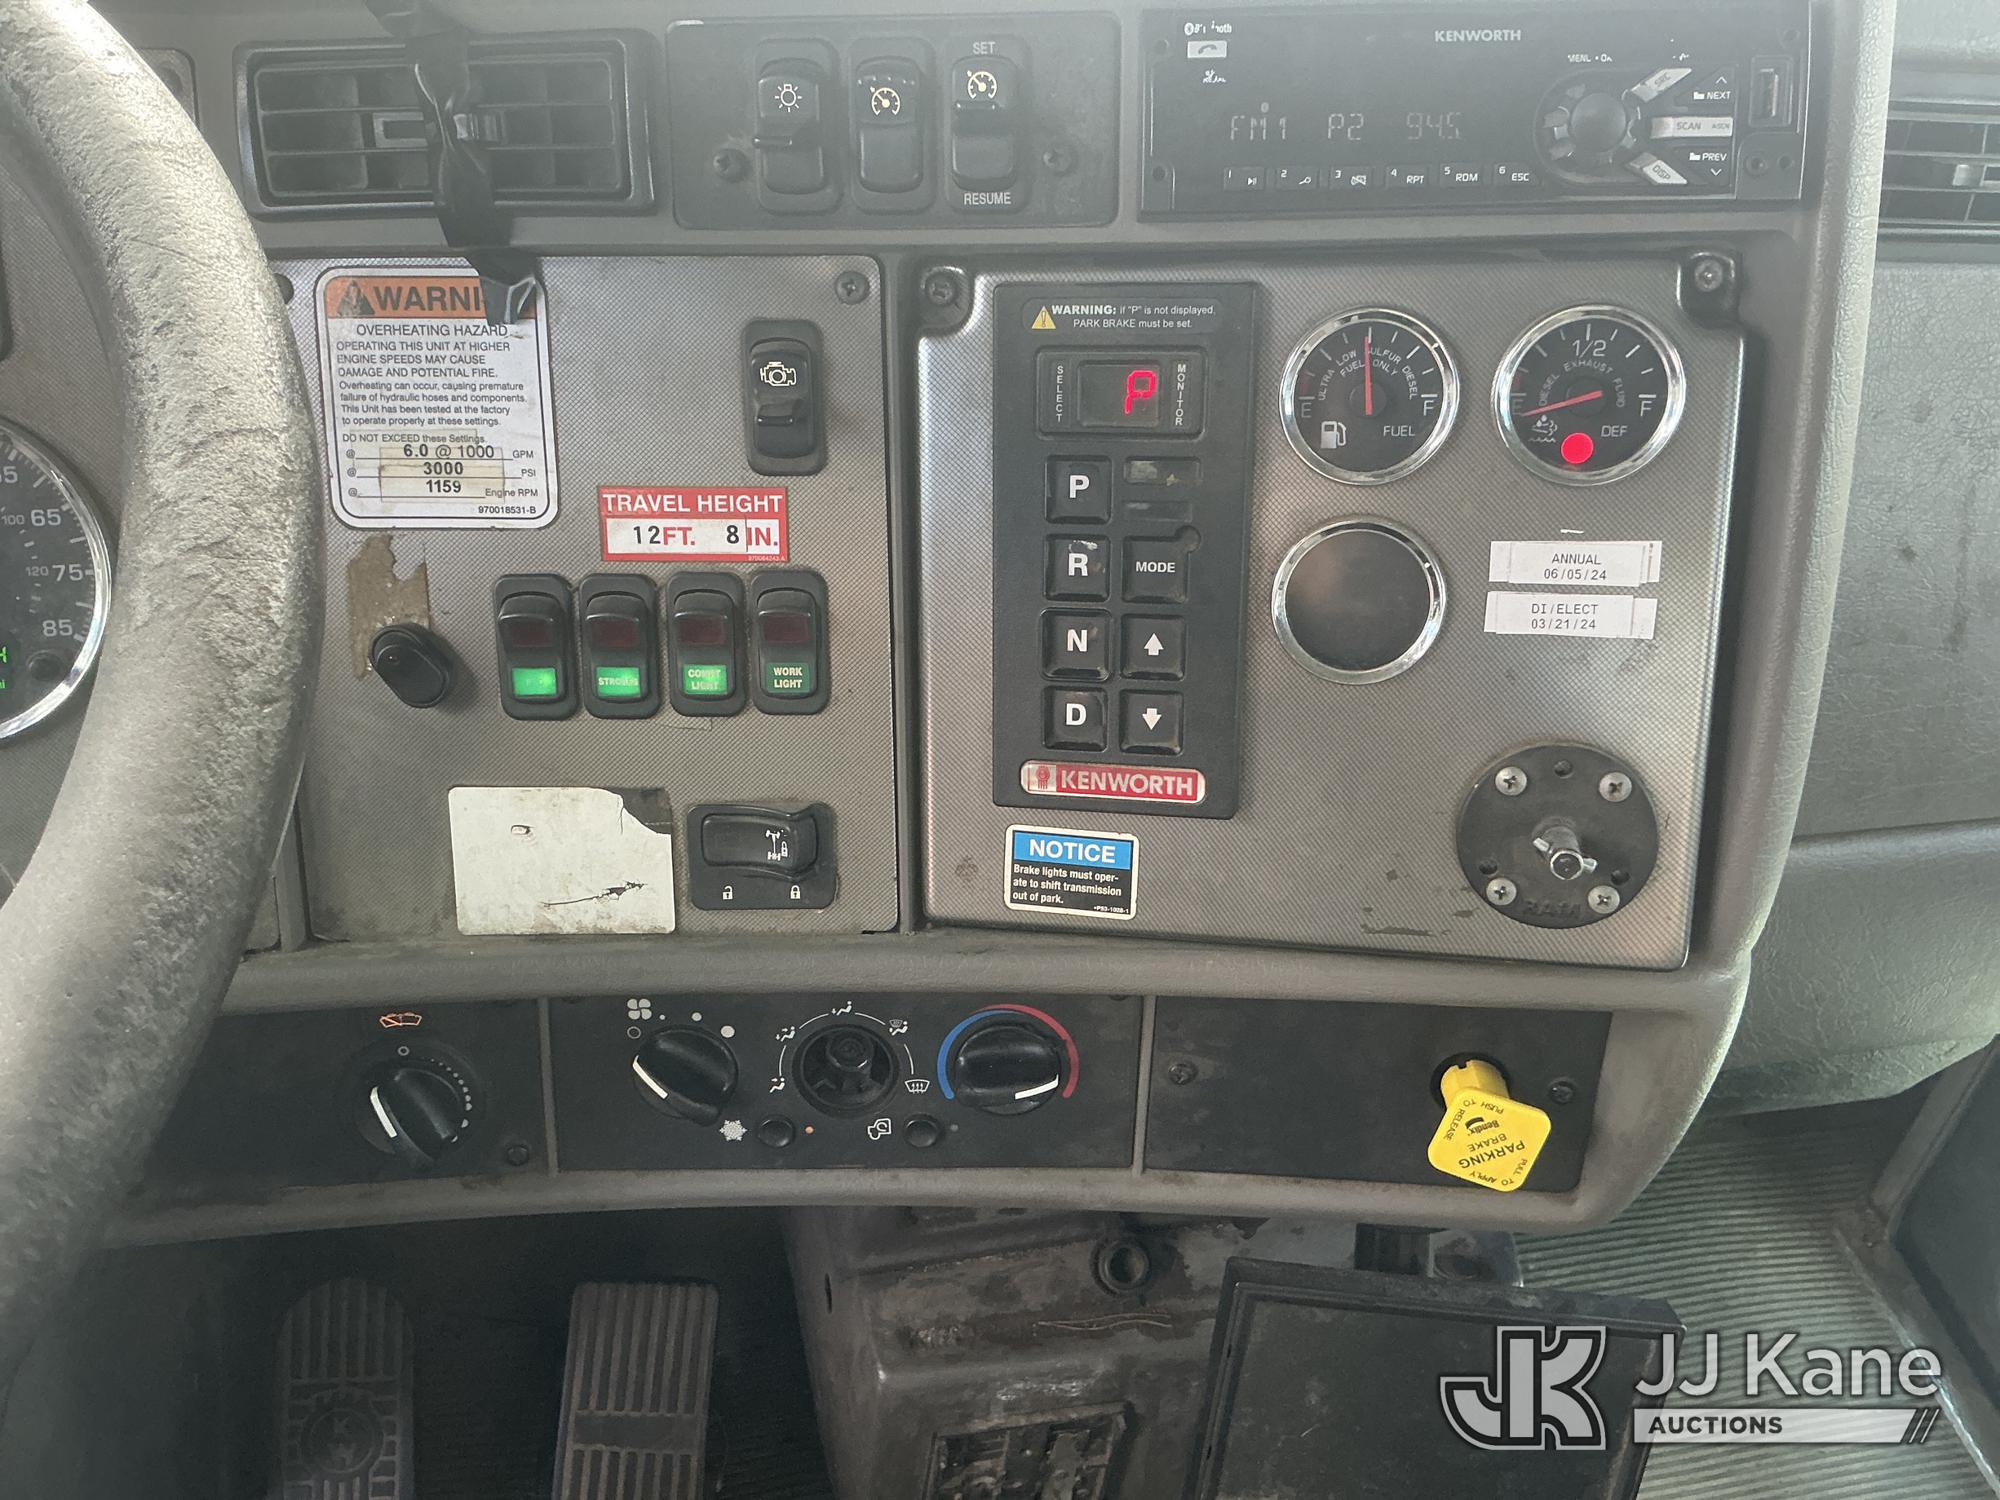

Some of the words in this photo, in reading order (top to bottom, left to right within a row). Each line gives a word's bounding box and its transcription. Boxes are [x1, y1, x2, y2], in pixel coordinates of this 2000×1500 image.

[1434, 29, 1521, 42] KENWORTH
[972, 42, 995, 54] SET
[1706, 92, 1731, 100] NEXT
[1328, 113, 1364, 140] P2
[1676, 122, 1702, 131] SCAN
[1702, 152, 1727, 161] PREV
[1280, 169, 1288, 178] 2
[1335, 169, 1342, 178] 3
[1390, 168, 1397, 177] 4
[1406, 174, 1425, 184] RPT
[1455, 172, 1479, 182] RDM
[1499, 165, 1506, 174] 6
[1511, 172, 1530, 182] ESC
[1652, 164, 1671, 181] DISP
[964, 192, 1011, 205] RESUME
[373, 286, 486, 311] WARNI
[1052, 305, 1116, 314] WARNING:
[1145, 306, 1151, 314] is
[1171, 306, 1215, 316] displayed.
[356, 324, 450, 336] OVERHEATING
[454, 325, 508, 336] HAZARD
[1074, 319, 1100, 327] PARK
[1103, 319, 1135, 328] BRAKE
[1139, 320, 1160, 328] must
[1163, 319, 1174, 328] be
[1177, 320, 1192, 328] set.
[336, 341, 396, 351] OPERATING
[400, 341, 423, 351] THIS
[426, 341, 450, 351] UNIT
[453, 342, 466, 351] AT
[469, 342, 510, 352] HIGHER
[1572, 340, 1607, 357] 1/2
[337, 354, 377, 364] ENGINE
[380, 354, 422, 364] SPEEDS
[425, 355, 447, 364] MAY
[450, 355, 486, 364] CAUSE
[338, 368, 383, 377] DAMAGE
[386, 368, 408, 377] AND
[411, 368, 469, 378] POTENTIAL
[472, 368, 498, 378] FIRE.
[1318, 369, 1335, 400] ULTRA
[1336, 350, 1357, 366] LOW
[1368, 348, 1402, 364] ULFUR
[1402, 365, 1418, 399] DIESEL
[1340, 360, 1365, 378] FUEL
[1372, 359, 1399, 376] ONLY
[339, 381, 392, 391] Overheating
[394, 382, 411, 390] can
[413, 382, 440, 391] occur,
[442, 382, 476, 392] causing
[480, 383, 524, 392] premature
[1539, 373, 1560, 406] DIESEL
[1563, 359, 1613, 374] EXHAUST
[1613, 378, 1625, 407] FLUID
[340, 393, 367, 401] failure
[380, 393, 420, 403] hydraulic
[422, 393, 449, 402] hoses
[452, 394, 468, 402] and
[470, 394, 527, 403] components.
[1056, 365, 1064, 422] SELECT
[1124, 370, 1158, 414] P
[1175, 364, 1186, 425] MONITOR
[341, 405, 360, 413] This
[362, 405, 380, 413] Unit
[382, 405, 398, 413] has
[400, 405, 422, 413] been
[424, 405, 451, 414] tested
[454, 406, 462, 414] at
[464, 406, 479, 414] the
[480, 406, 510, 416] factory
[1301, 402, 1312, 418] E
[1423, 400, 1433, 416] F
[1640, 401, 1652, 416] F
[353, 417, 386, 426] operate
[388, 417, 425, 426] properly
[464, 417, 501, 427] settings.
[1383, 426, 1415, 436] FUEL
[1601, 425, 1628, 437] DEF
[342, 434, 356, 442] DO
[360, 434, 378, 442] NOT
[382, 434, 420, 442] EXCEED
[422, 434, 446, 442] these
[449, 434, 486, 444] Settings.
[403, 444, 428, 457] 6.0
[436, 444, 452, 460] @
[458, 445, 494, 458] 1000
[512, 450, 534, 458] GPM
[423, 462, 464, 475] 3000
[521, 469, 536, 477] PSI
[425, 480, 462, 492] 1159
[485, 488, 516, 498] Engine
[1068, 474, 1090, 498] P
[478, 506, 536, 514] 970018531-B
[603, 494, 690, 512] TRAVEL
[697, 495, 783, 513] HEIGHT
[1, 514, 25, 525] 100
[31, 509, 61, 526] 65
[727, 525, 739, 544] 8
[748, 527, 778, 546] IN.
[1068, 553, 1089, 576] R
[1552, 553, 1601, 565] ANNUAL
[25, 566, 49, 576] 120
[52, 564, 83, 582] 75
[1135, 561, 1176, 573] MODE
[1544, 569, 1607, 580] 06/05/24
[1531, 604, 1598, 614] DI/ELECT
[42, 619, 73, 637] 85
[1531, 619, 1596, 629] 03/21/24
[1067, 629, 1088, 652] N
[774, 667, 803, 676] WORK
[774, 679, 803, 688] LIGHT
[1065, 703, 1087, 726] D
[1061, 770, 1193, 796] KENWORTH
[1029, 839, 1116, 863] NOTICE
[1014, 864, 1040, 874] Brake
[1042, 867, 1067, 878] lights
[1070, 870, 1092, 879] must
[1095, 873, 1118, 883] oper-
[1013, 878, 1027, 886] ate
[1030, 879, 1038, 888] to
[1041, 880, 1061, 890] shift
[1063, 882, 1122, 896] transmission
[1013, 891, 1028, 900] out
[1030, 892, 1038, 901] of
[1041, 894, 1064, 904] park.
[1463, 1099, 1476, 1107] TO
[1480, 1101, 1504, 1114] PUSH
[1444, 1109, 1465, 1140] RELEASE
[1469, 1120, 1500, 1135] Bendix
[1468, 1133, 1507, 1152] BRAKE
[1458, 1140, 1525, 1169] PARKING
[1501, 1178, 1514, 1186] TO
